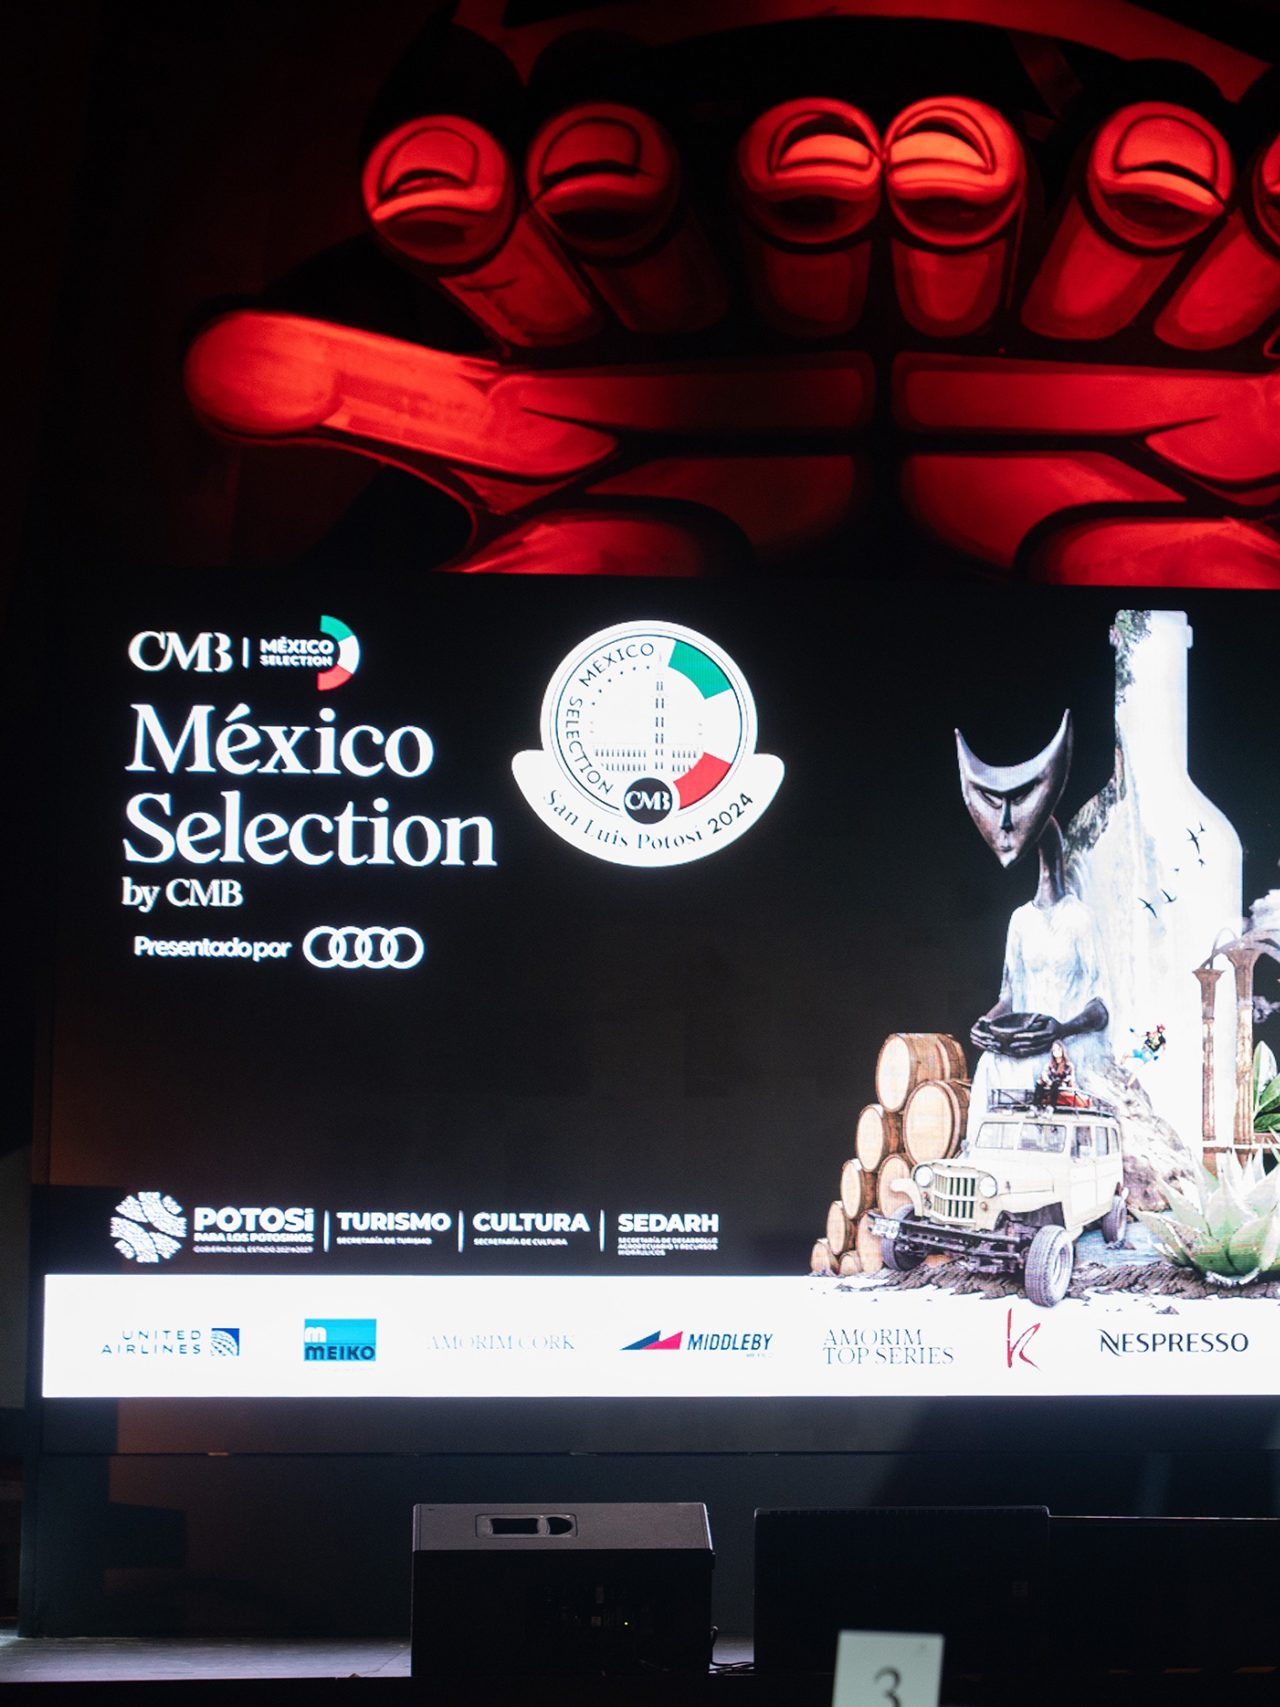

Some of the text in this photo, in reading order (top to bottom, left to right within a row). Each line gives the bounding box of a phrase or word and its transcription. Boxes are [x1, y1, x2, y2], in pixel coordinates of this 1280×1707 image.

[128, 630, 233, 672] CMB
[260, 636, 335, 655] MÉXICO
[260, 655, 333, 667] SELECTION
[125, 703, 434, 777] México
[566, 696, 614, 794] SELECTION
[624, 790, 671, 811] CMB
[122, 790, 498, 867] Selection
[545, 789, 579, 826] San
[583, 819, 629, 848] Luis
[707, 792, 754, 834] 2024
[122, 877, 243, 912] by CMB
[134, 935, 292, 962] Presentado por
[336, 1212, 452, 1231] TURISMO
[473, 1212, 591, 1232] CULTURA
[618, 1213, 719, 1232] SEDARH
[122, 1330, 201, 1341] UNITED
[687, 1333, 773, 1351] MIDDLEBY
[824, 1329, 922, 1346] AMORIM
[1097, 1329, 1249, 1357] NESPRESSO
[102, 1344, 201, 1355] AIRLINES
[305, 1345, 375, 1361] MEIKO
[822, 1347, 955, 1365] TOP SERIES
[873, 1666, 903, 1707] 3
